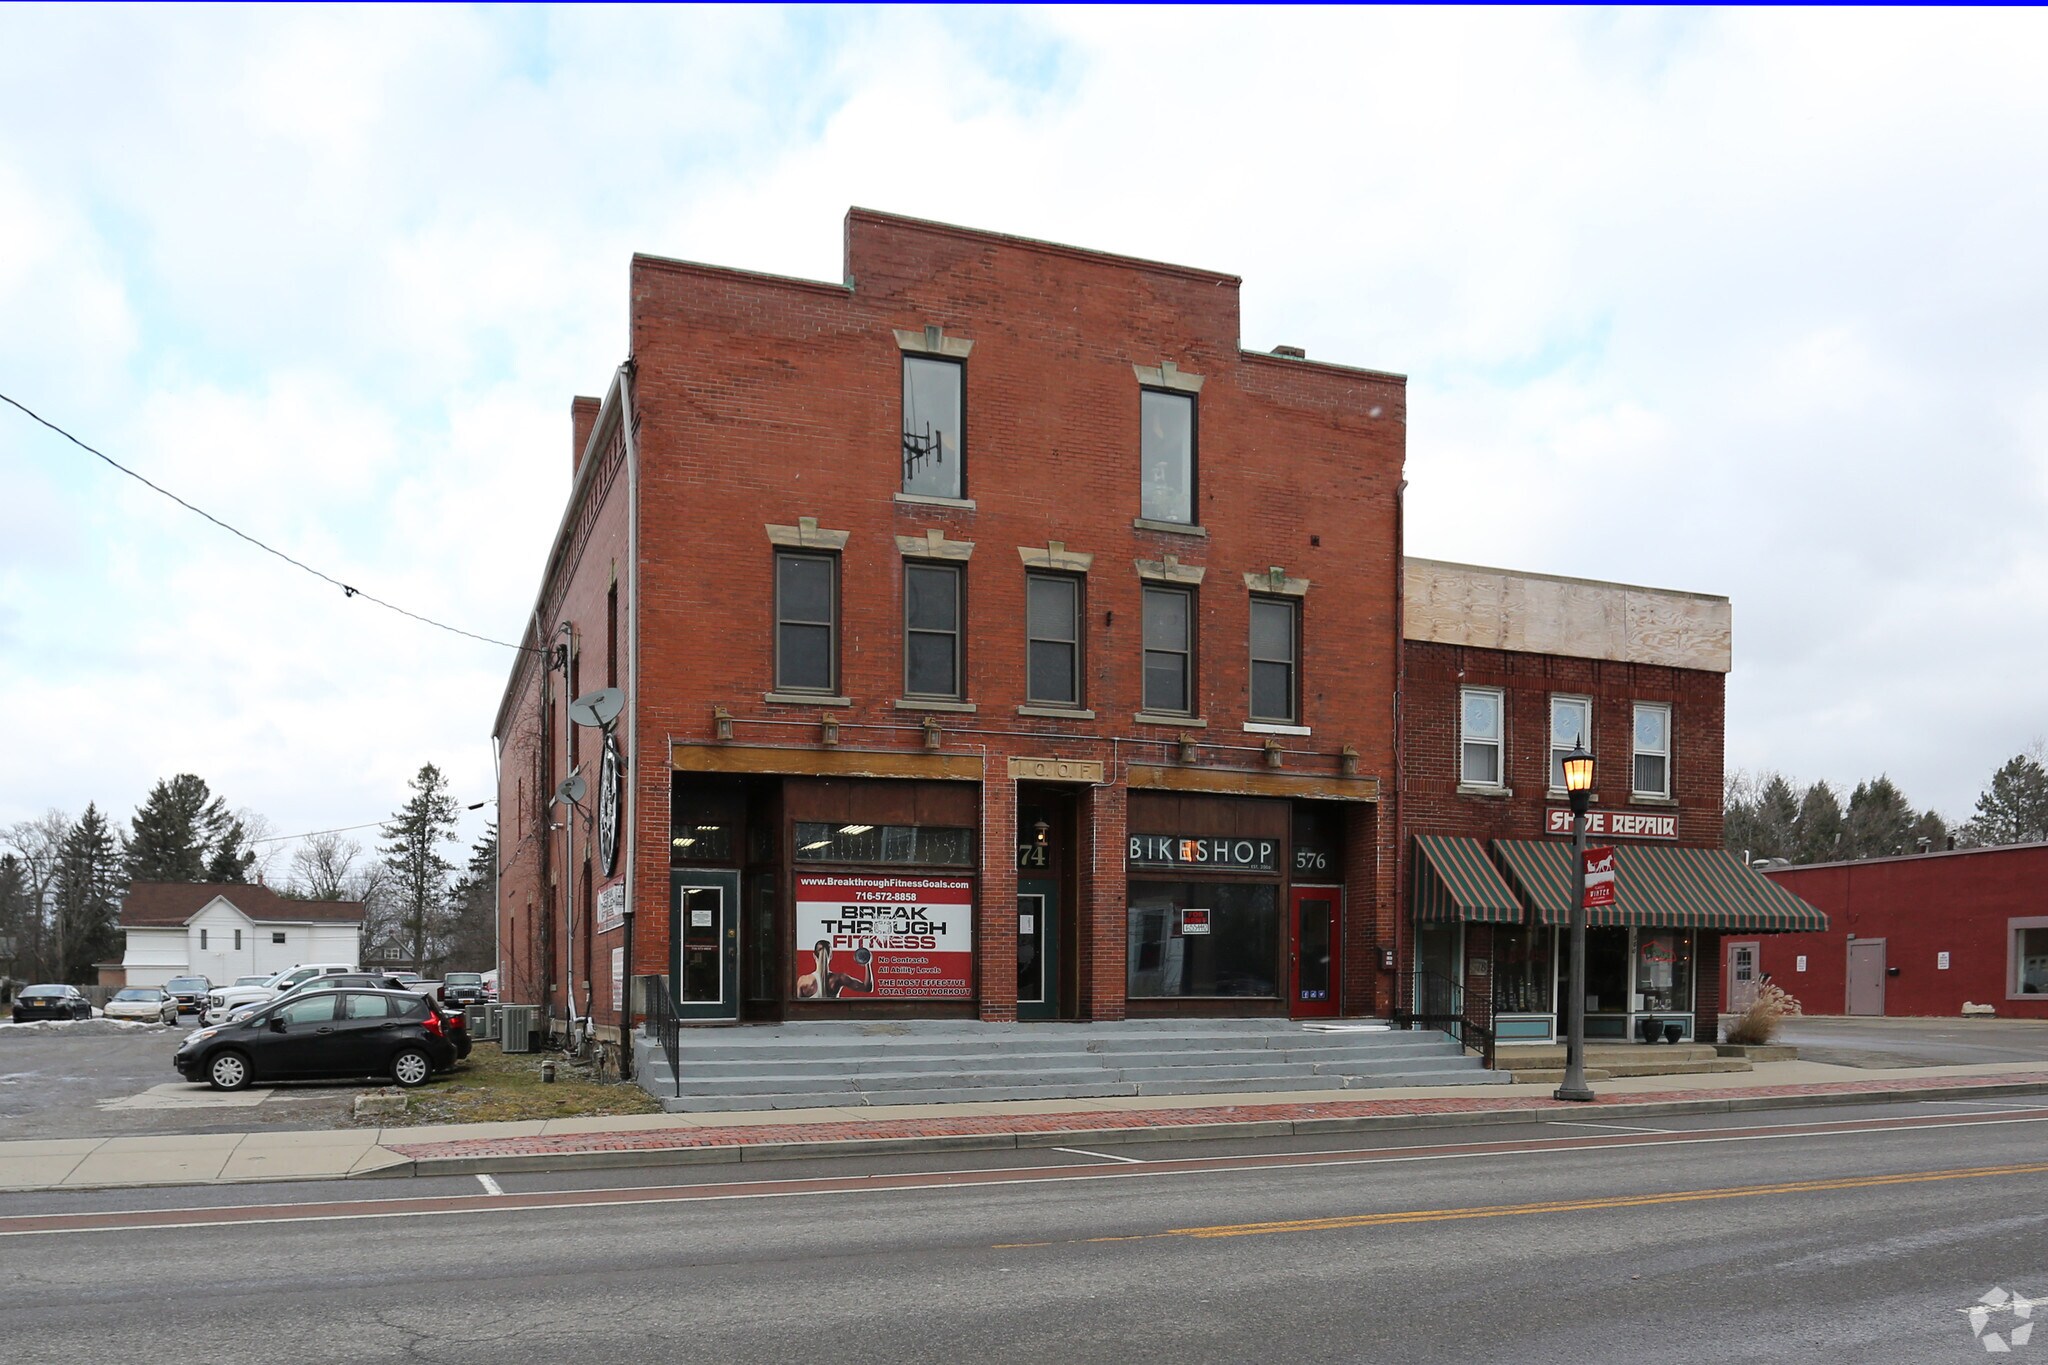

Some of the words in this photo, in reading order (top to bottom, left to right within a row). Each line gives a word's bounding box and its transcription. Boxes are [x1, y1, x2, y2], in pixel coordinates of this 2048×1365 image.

[1612, 814, 1675, 836] REPAIR
[1296, 852, 1326, 869] 576
[800, 877, 969, 889] www.BreakthroughFitnessGoals.com
[855, 891, 917, 902] 716-572-8858
[841, 905, 928, 921] BREAK
[821, 919, 947, 935] THROUGH
[832, 935, 937, 950] FITNESS
[878, 956, 889, 964] No
[890, 956, 929, 964] Contracts
[878, 966, 888, 974] All
[890, 966, 915, 975] Ability
[916, 966, 941, 974] Levels
[878, 979, 895, 987] THE
[896, 979, 920, 987] MOST
[921, 979, 966, 987] EFFECTIVE
[930, 988, 971, 996] WORKOUT
